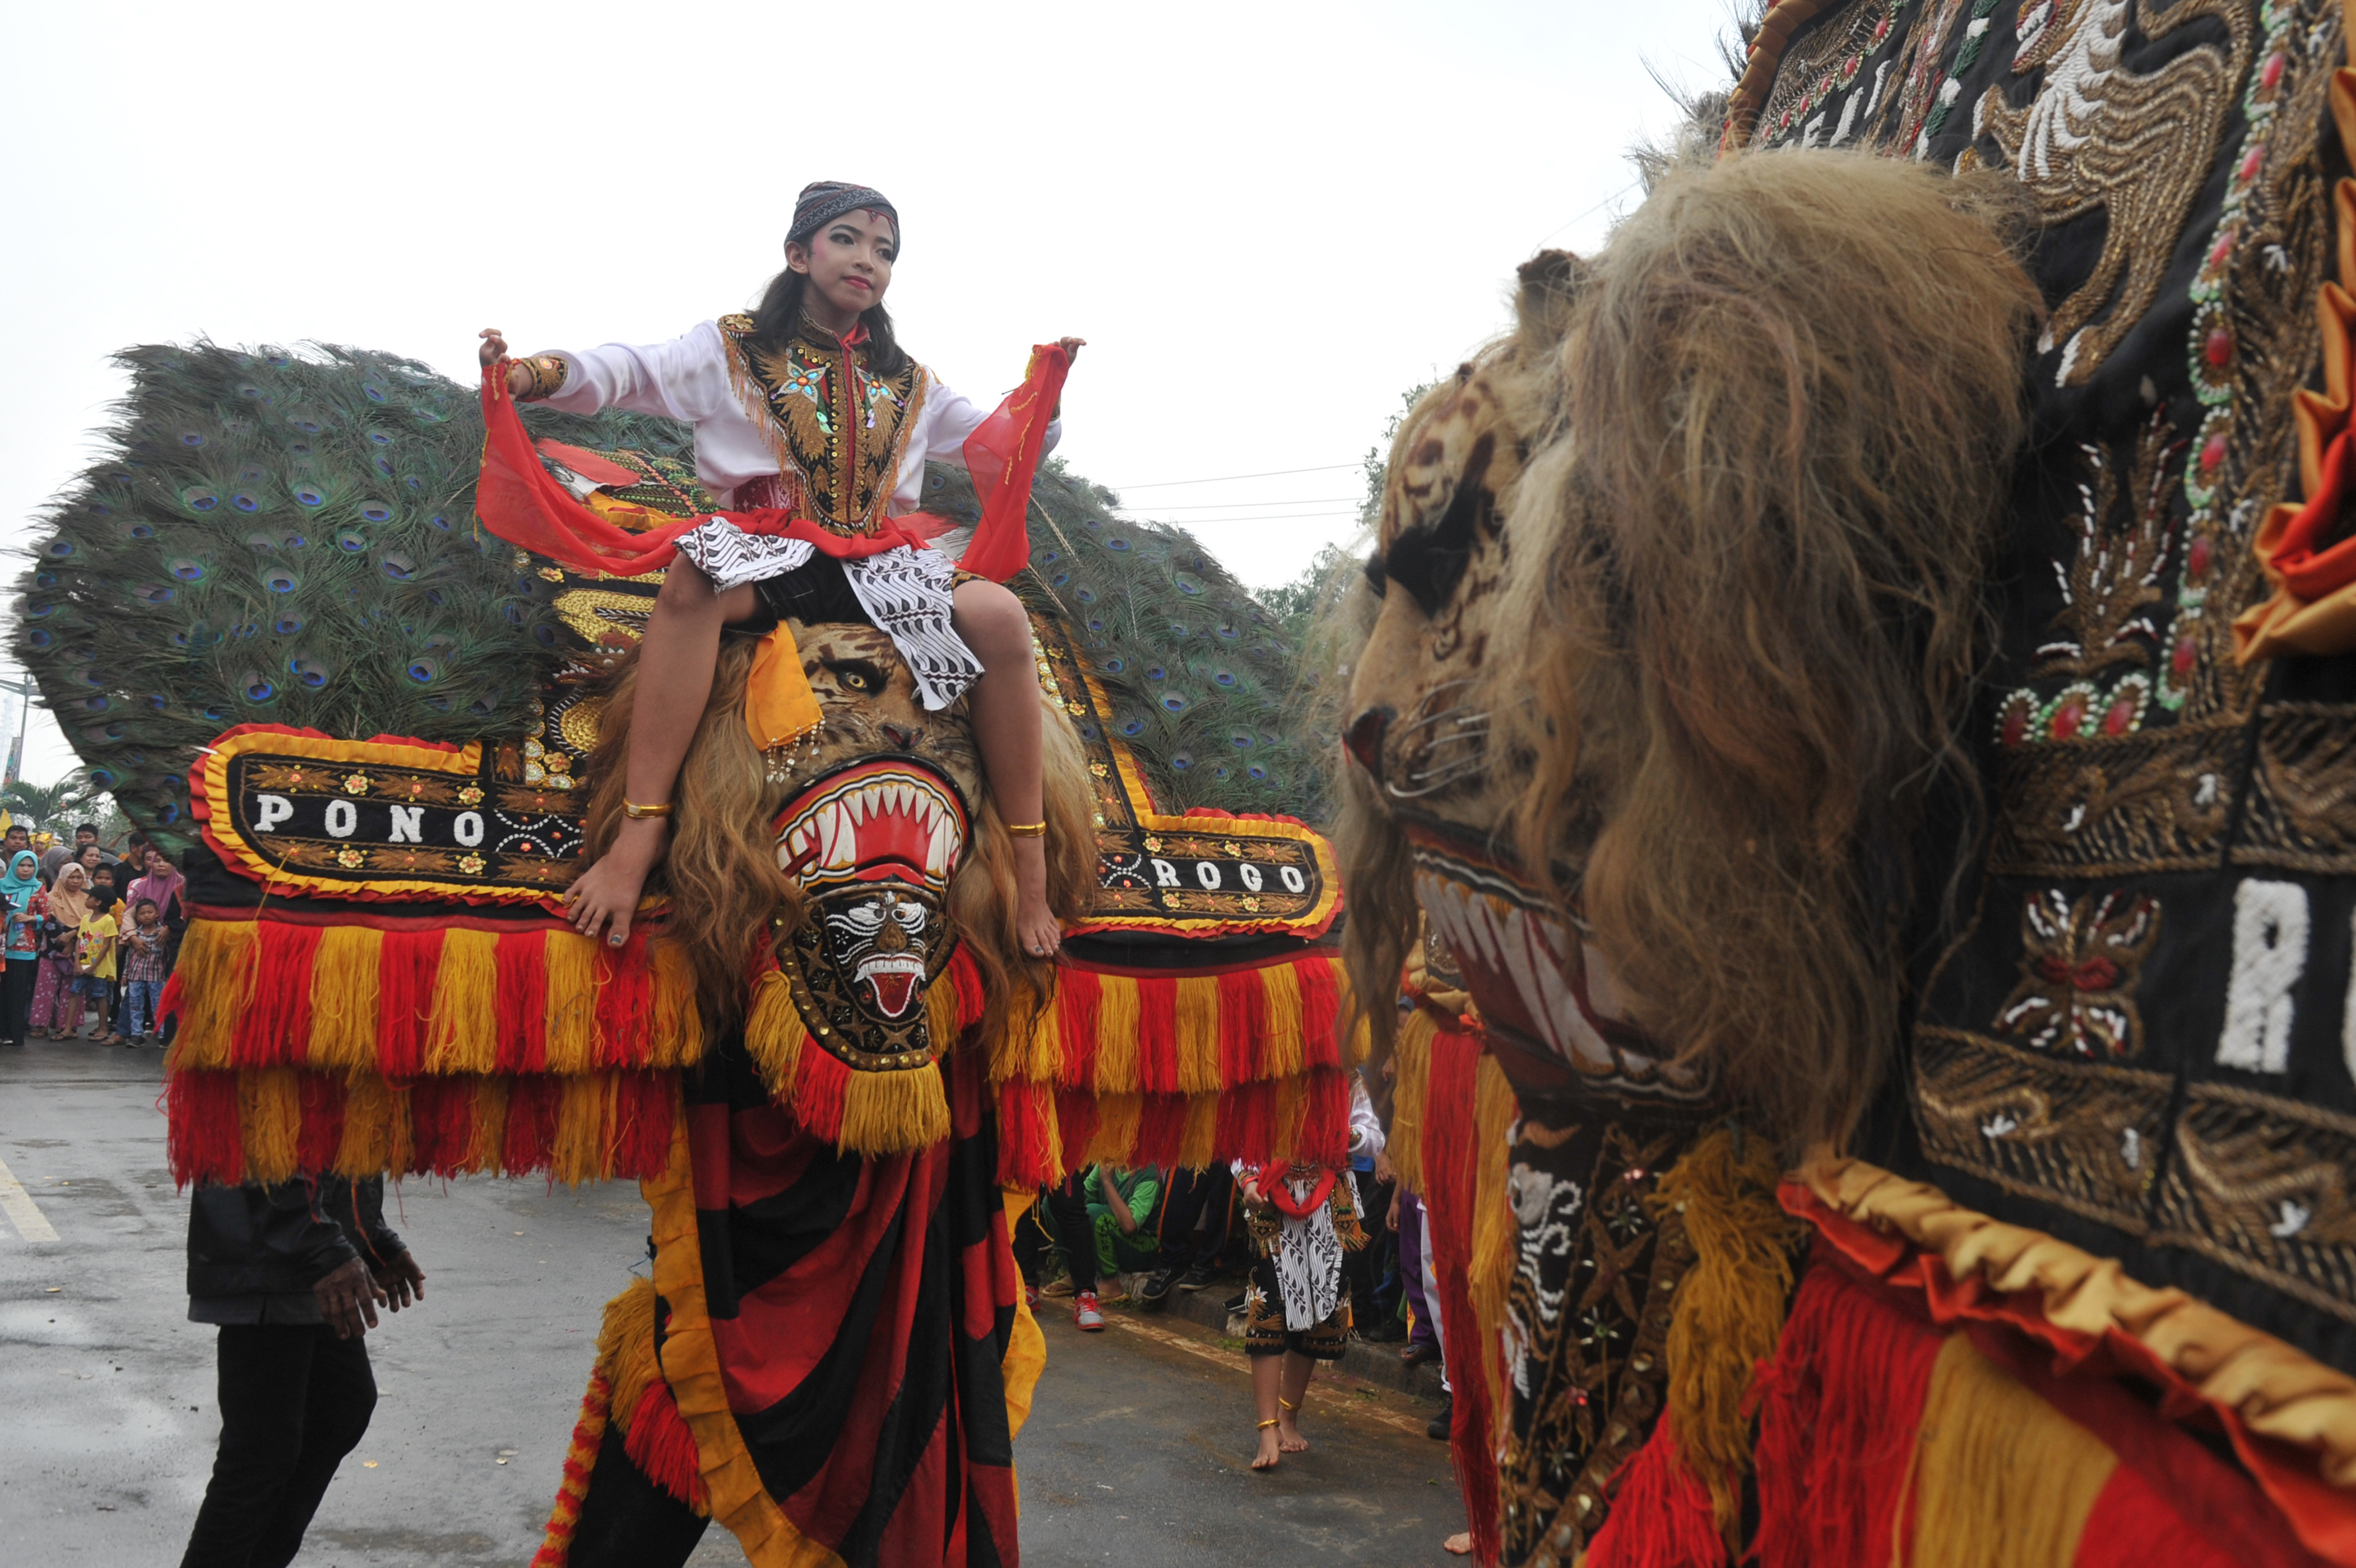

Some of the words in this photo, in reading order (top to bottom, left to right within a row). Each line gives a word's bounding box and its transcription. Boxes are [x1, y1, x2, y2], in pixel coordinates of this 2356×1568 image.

[253, 794, 484, 847] PONO
[1150, 858, 1305, 894] ROGO
[2214, 877, 2356, 1089] R
